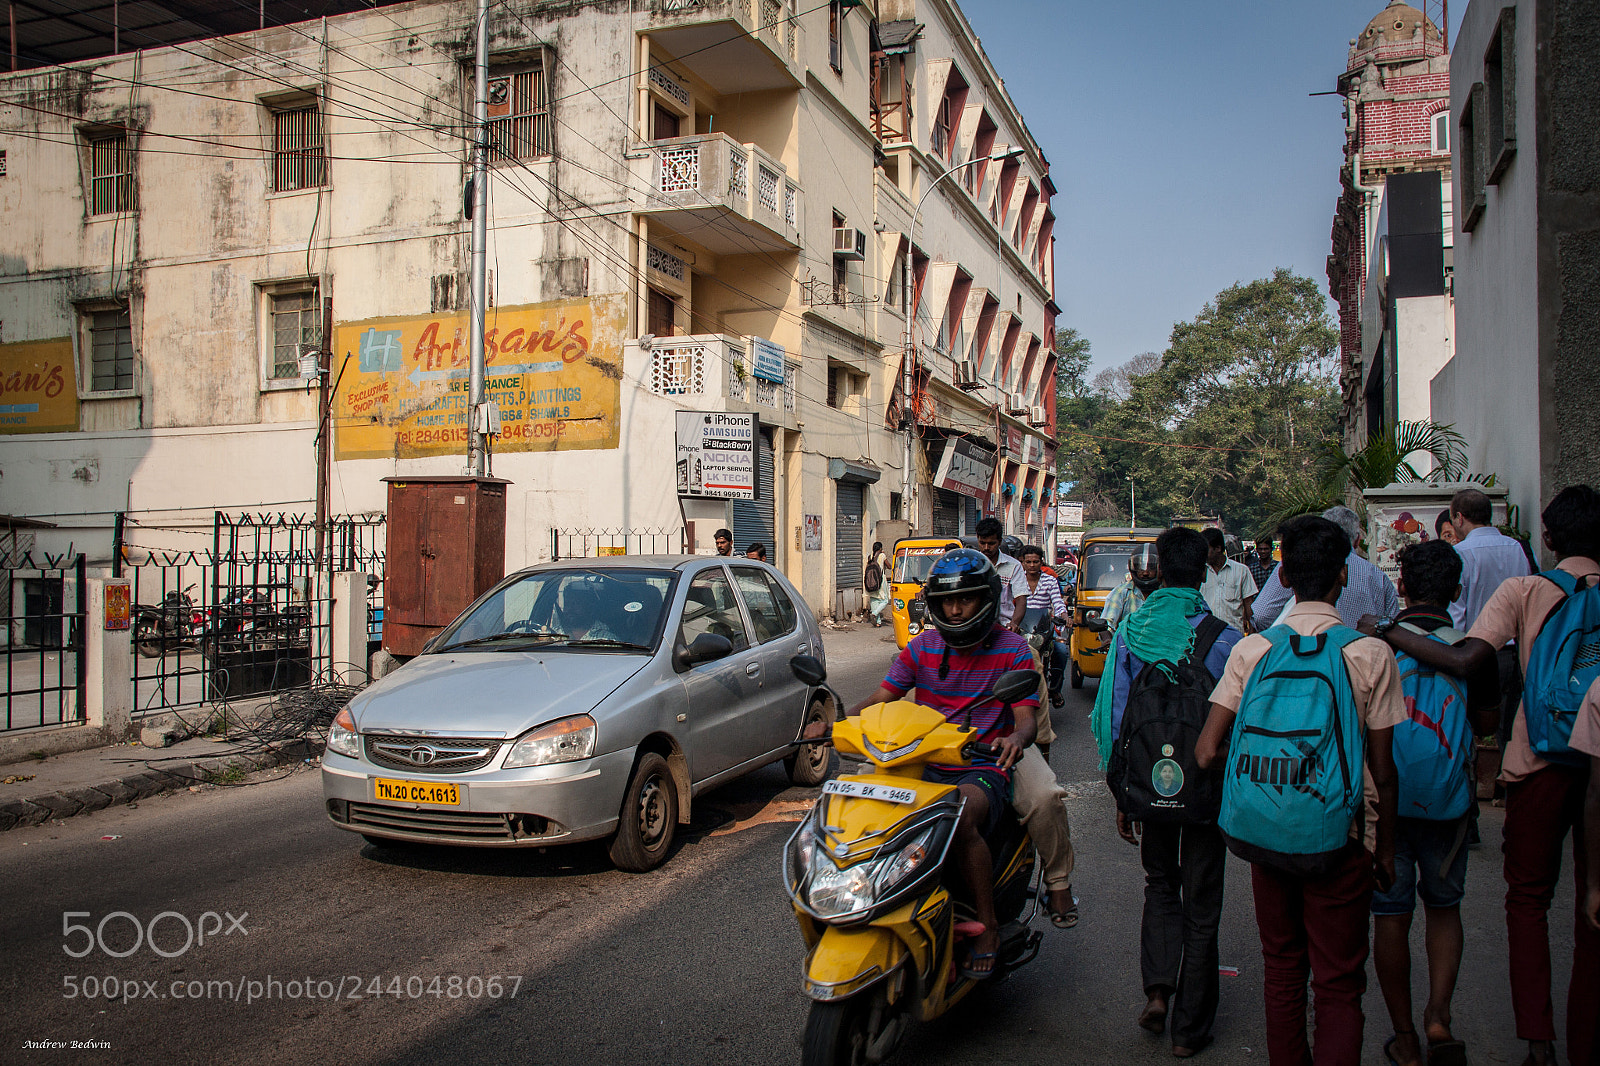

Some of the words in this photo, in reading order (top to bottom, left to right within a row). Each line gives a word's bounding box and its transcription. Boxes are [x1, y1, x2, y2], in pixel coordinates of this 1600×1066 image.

[413, 317, 588, 371] Artsan's
[0, 361, 64, 398] an's
[347, 381, 389, 405] EXCLUSIVE
[351, 398, 373, 415] SHOP
[416, 414, 445, 427] HOME
[529, 406, 570, 420] SHAWLS
[715, 414, 750, 426] iPhone
[703, 427, 751, 438] SAMSUNG
[678, 444, 700, 453] iPhone
[711, 440, 751, 451] BlackBerry
[703, 452, 751, 464] NOKIA
[706, 473, 719, 481] LK
[722, 474, 749, 483] TECH
[1236, 753, 1318, 785] PUMA
[378, 784, 407, 800] TN.20
[411, 787, 457, 803] CC.1613
[827, 782, 839, 791] TN
[840, 784, 851, 793] 05
[862, 787, 875, 796] BK
[888, 790, 912, 802] 9466
